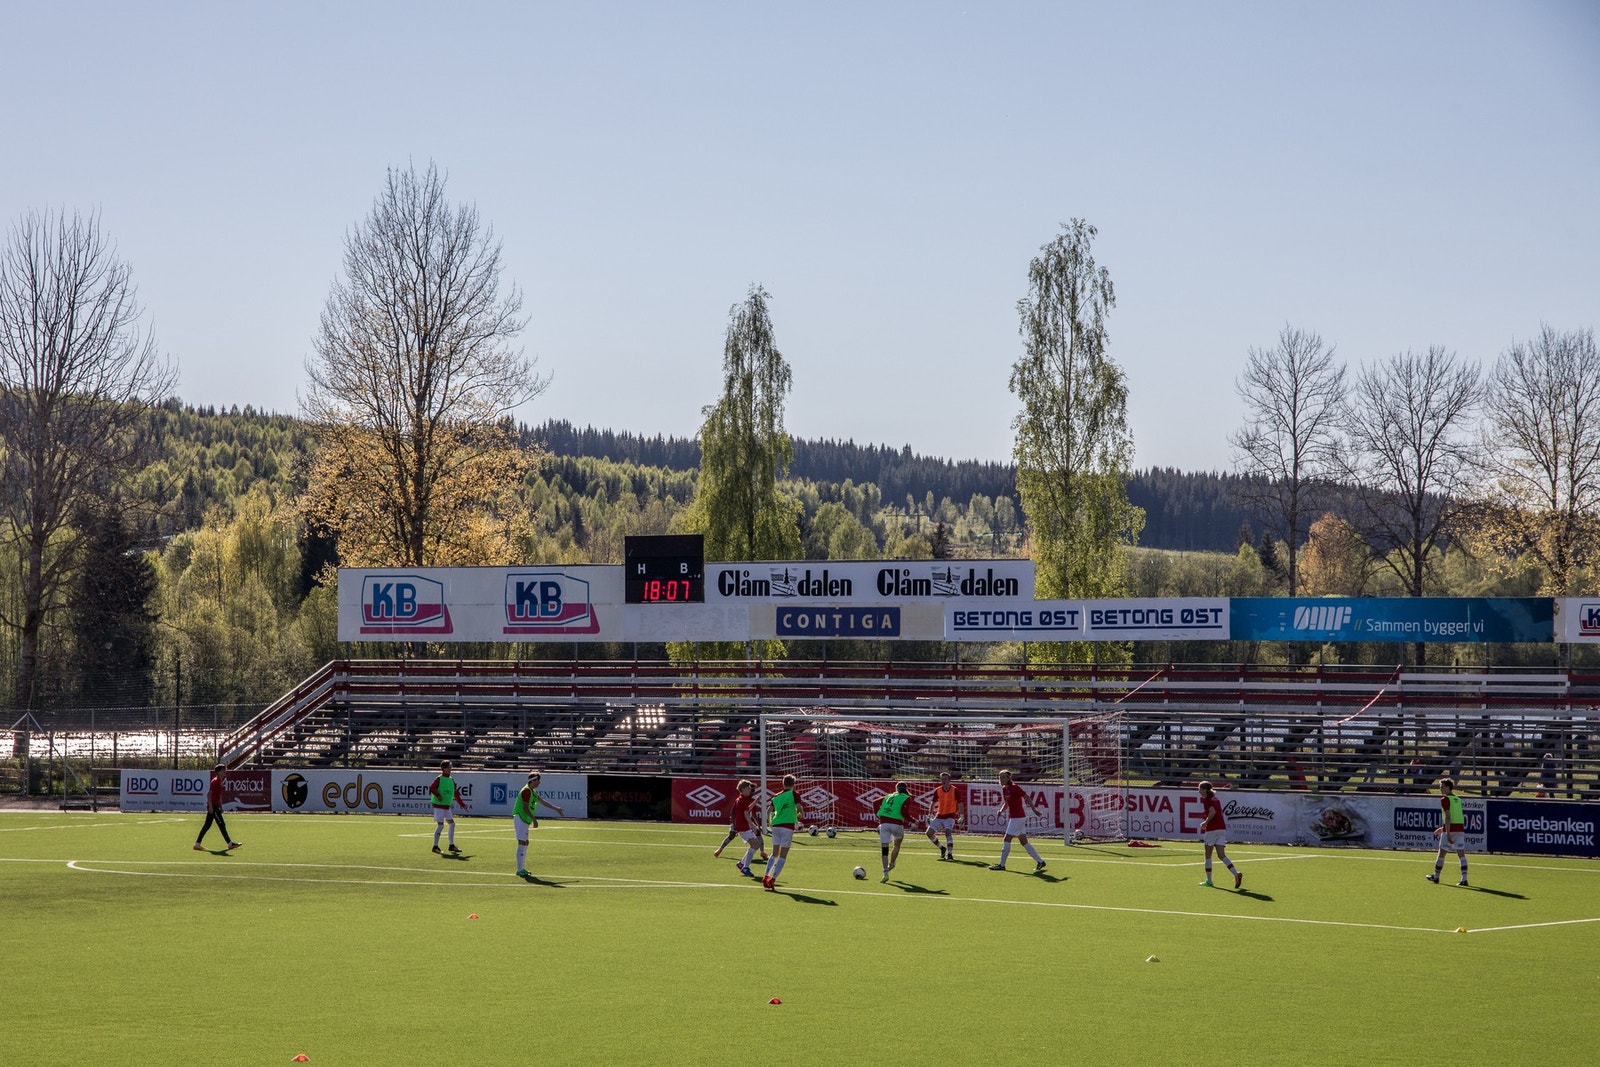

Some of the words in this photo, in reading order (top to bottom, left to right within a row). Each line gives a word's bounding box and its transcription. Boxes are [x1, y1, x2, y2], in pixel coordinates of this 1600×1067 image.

[637, 563, 646, 575] H
[680, 562, 689, 574] B
[643, 580, 691, 601] 18:07
[372, 582, 417, 617] KB
[515, 581, 562, 617] KB
[782, 613, 893, 629] CONTIGA
[953, 610, 1033, 626] BETONG
[1039, 610, 1079, 626] ØST
[1090, 609, 1173, 625] BETONG
[1180, 608, 1223, 624] ØST
[1366, 618, 1420, 633] Sammen
[1424, 618, 1469, 635] bygger
[1473, 619, 1485, 633] vi
[131, 777, 158, 791] BDO
[175, 778, 203, 792] BDO
[322, 773, 383, 810] eda
[392, 783, 473, 798] superket
[557, 790, 583, 801] DAHL
[887, 797, 896, 808] 4
[1090, 793, 1174, 813] EIDSIVA
[689, 808, 722, 818] umbro
[1222, 799, 1275, 819] Berggren
[1090, 813, 1174, 833] bredbånd
[1396, 810, 1425, 828] HAGEN
[1426, 812, 1433, 828] &
[1469, 814, 1482, 831] AS
[1498, 814, 1595, 833] Sparebanken
[1394, 832, 1426, 841] Skarnes
[1526, 832, 1595, 847] HEDMARK
